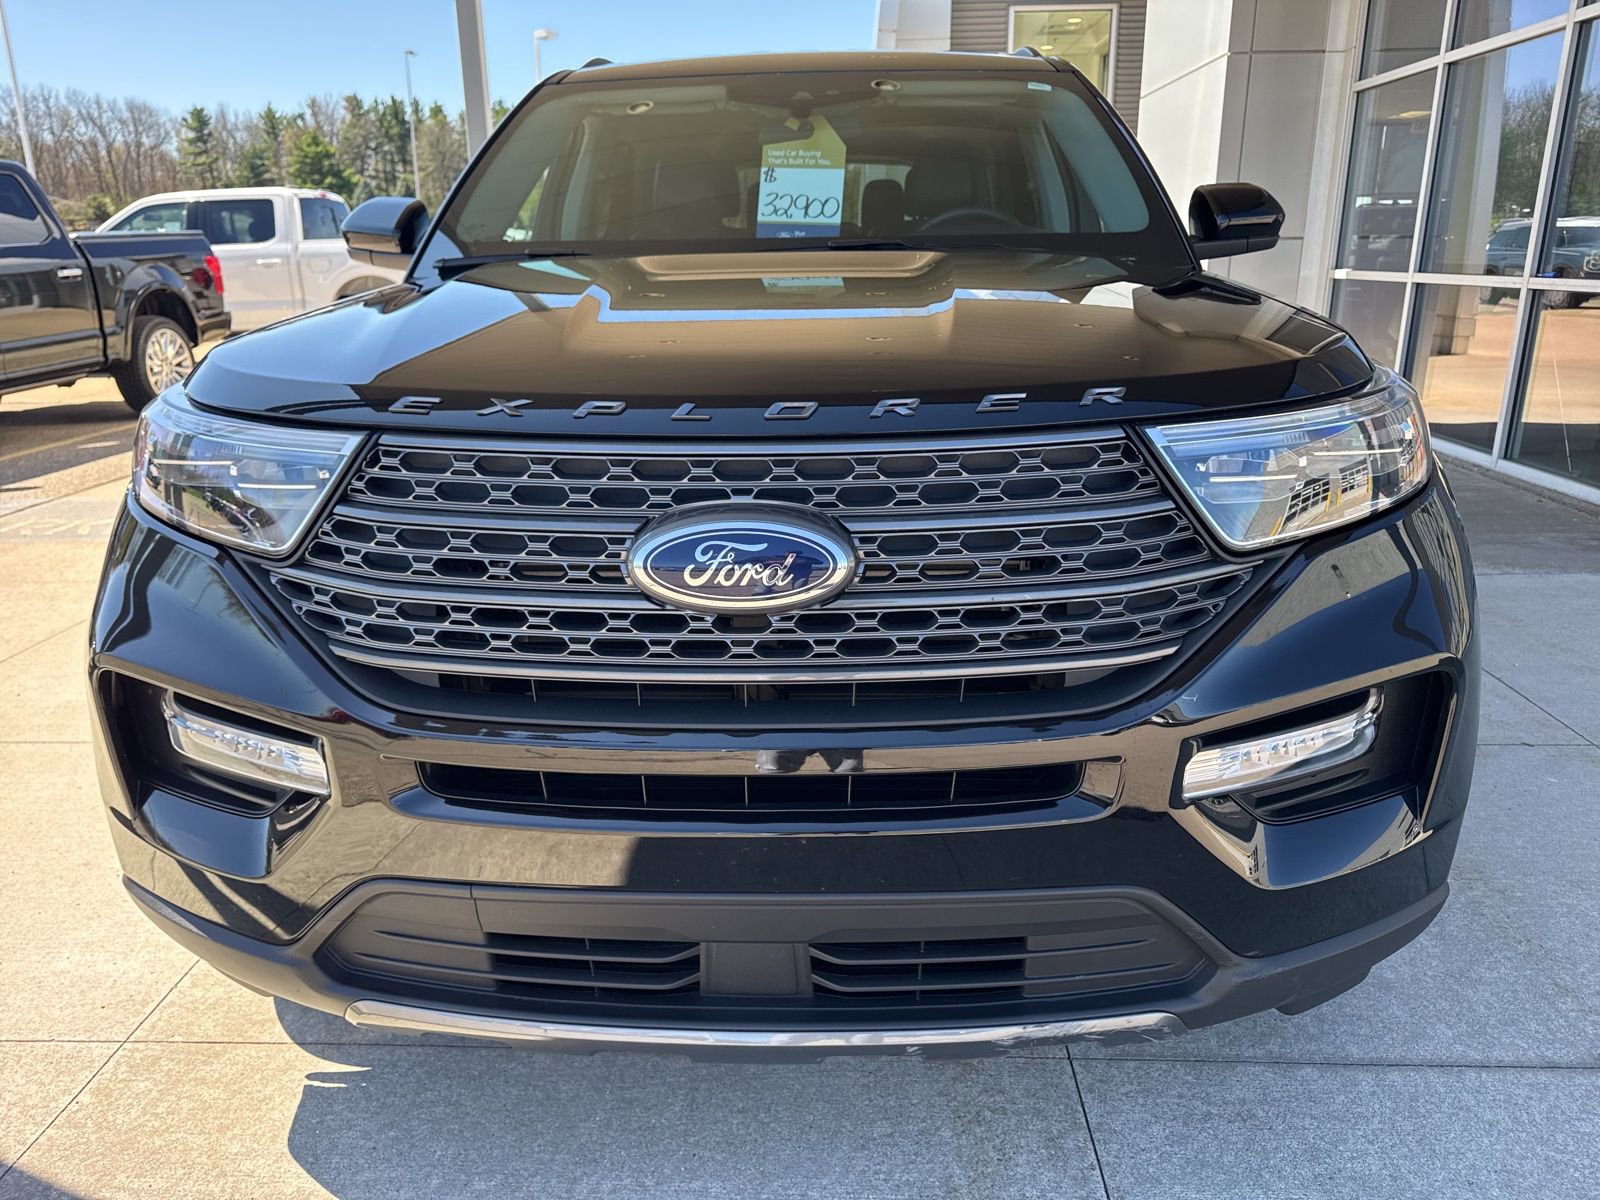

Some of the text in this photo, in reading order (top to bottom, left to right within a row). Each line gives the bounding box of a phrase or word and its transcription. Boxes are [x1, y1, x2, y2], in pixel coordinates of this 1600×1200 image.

[768, 149, 785, 157] Used
[799, 150, 822, 158] Buying
[768, 157, 787, 165] That's
[789, 157, 804, 165] Built
[388, 386, 1127, 421] EXPLORER
[683, 540, 797, 587] Ford
